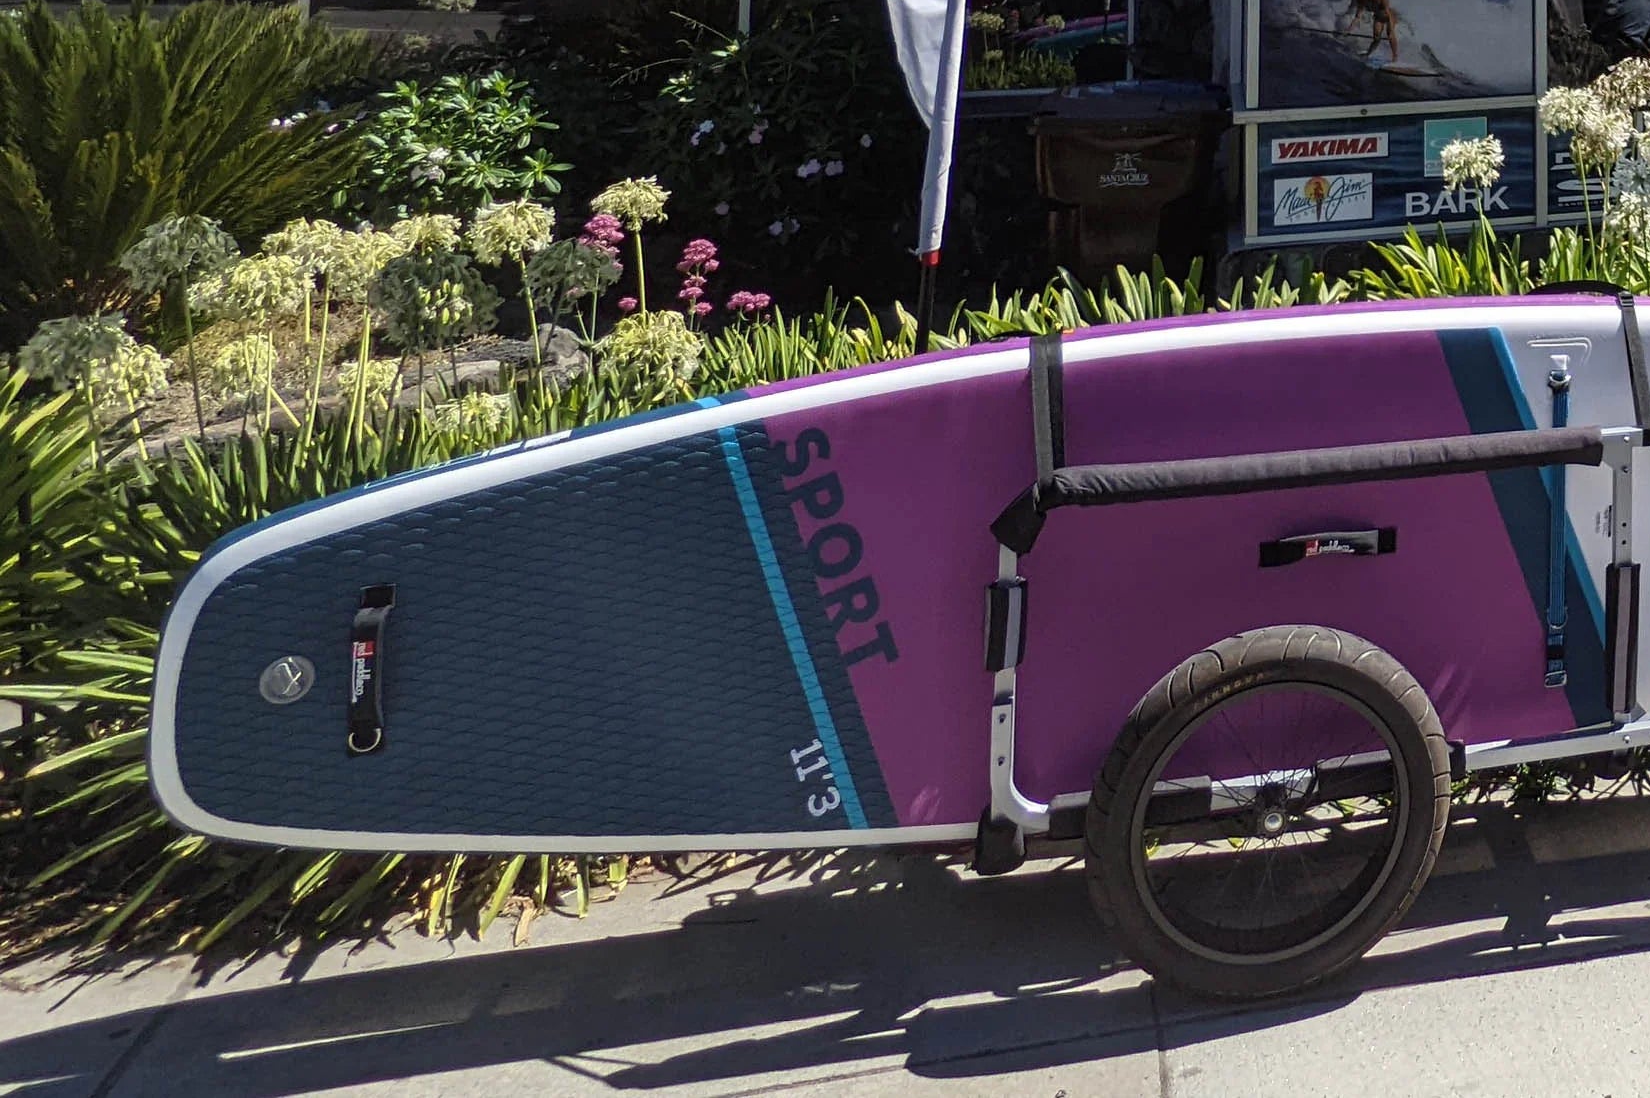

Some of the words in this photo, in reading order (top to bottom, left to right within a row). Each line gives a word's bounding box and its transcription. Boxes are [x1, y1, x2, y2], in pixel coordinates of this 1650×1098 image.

[1277, 137, 1379, 160] YAKIMA
[1326, 176, 1371, 220] Jim
[1405, 186, 1510, 217] BARK
[771, 427, 899, 667] SPORT
